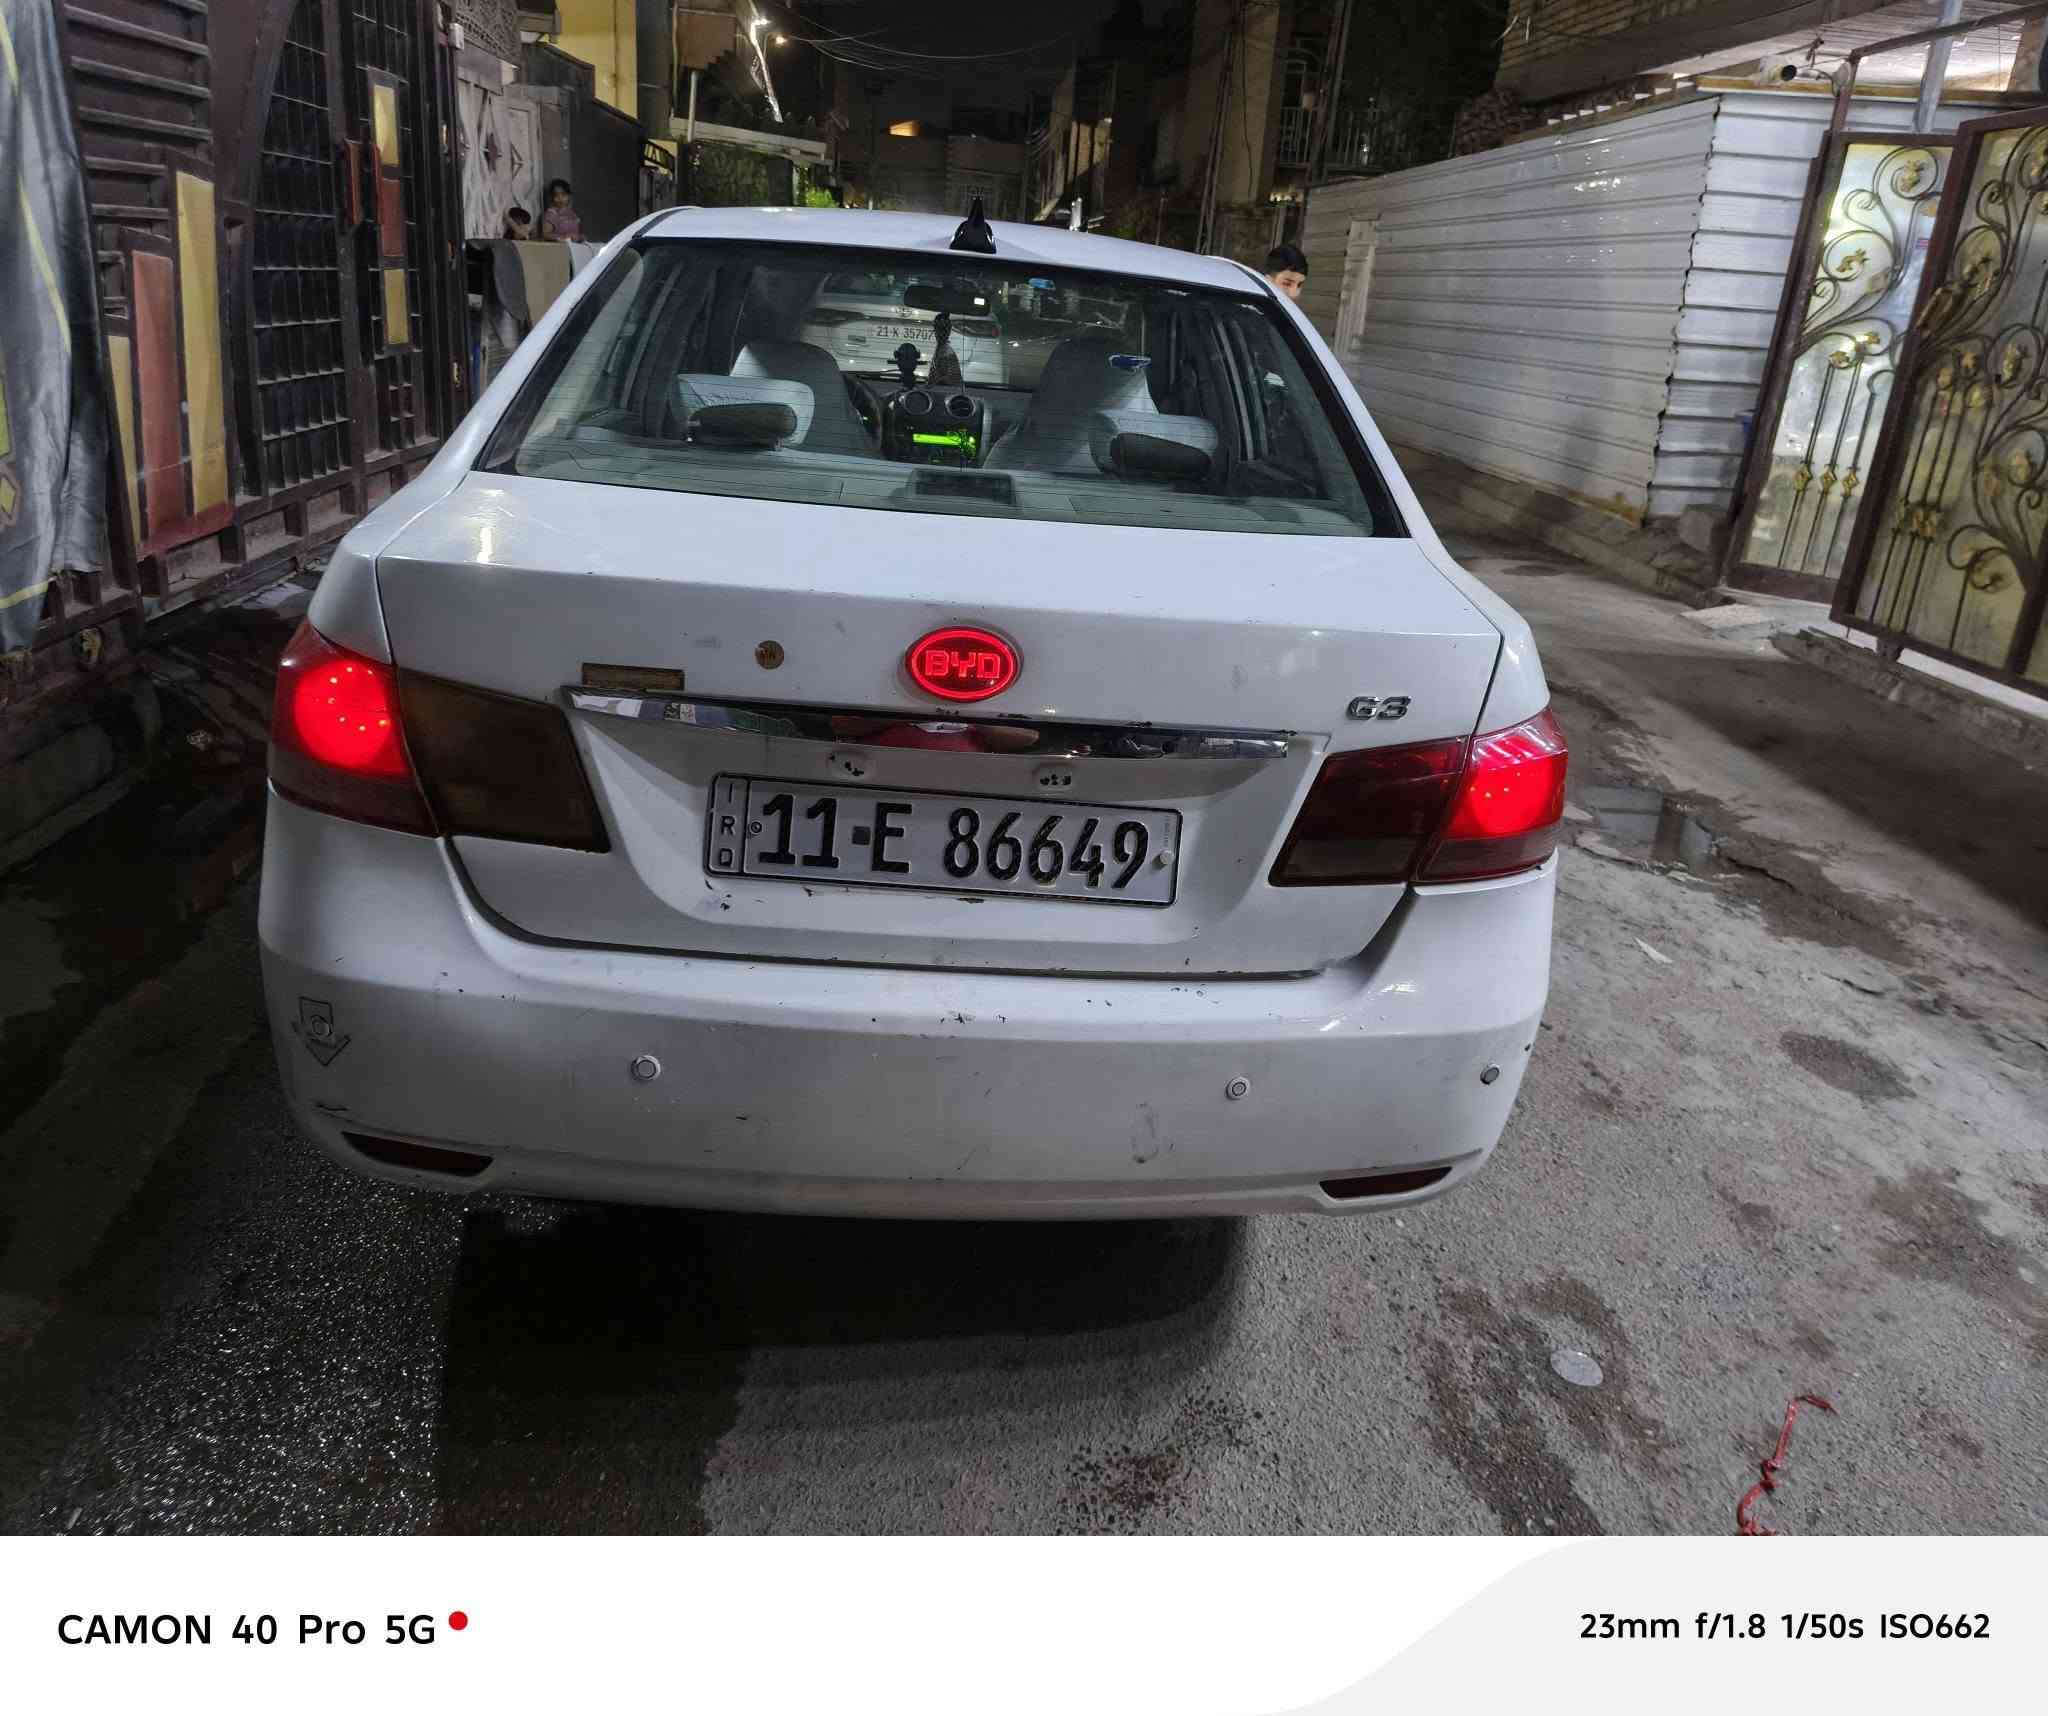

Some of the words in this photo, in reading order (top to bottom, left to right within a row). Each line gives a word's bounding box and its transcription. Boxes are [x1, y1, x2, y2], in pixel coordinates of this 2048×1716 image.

[925, 650, 1001, 679] BYD
[1346, 696, 1412, 721] G3
[944, 807, 1149, 889] 86649
